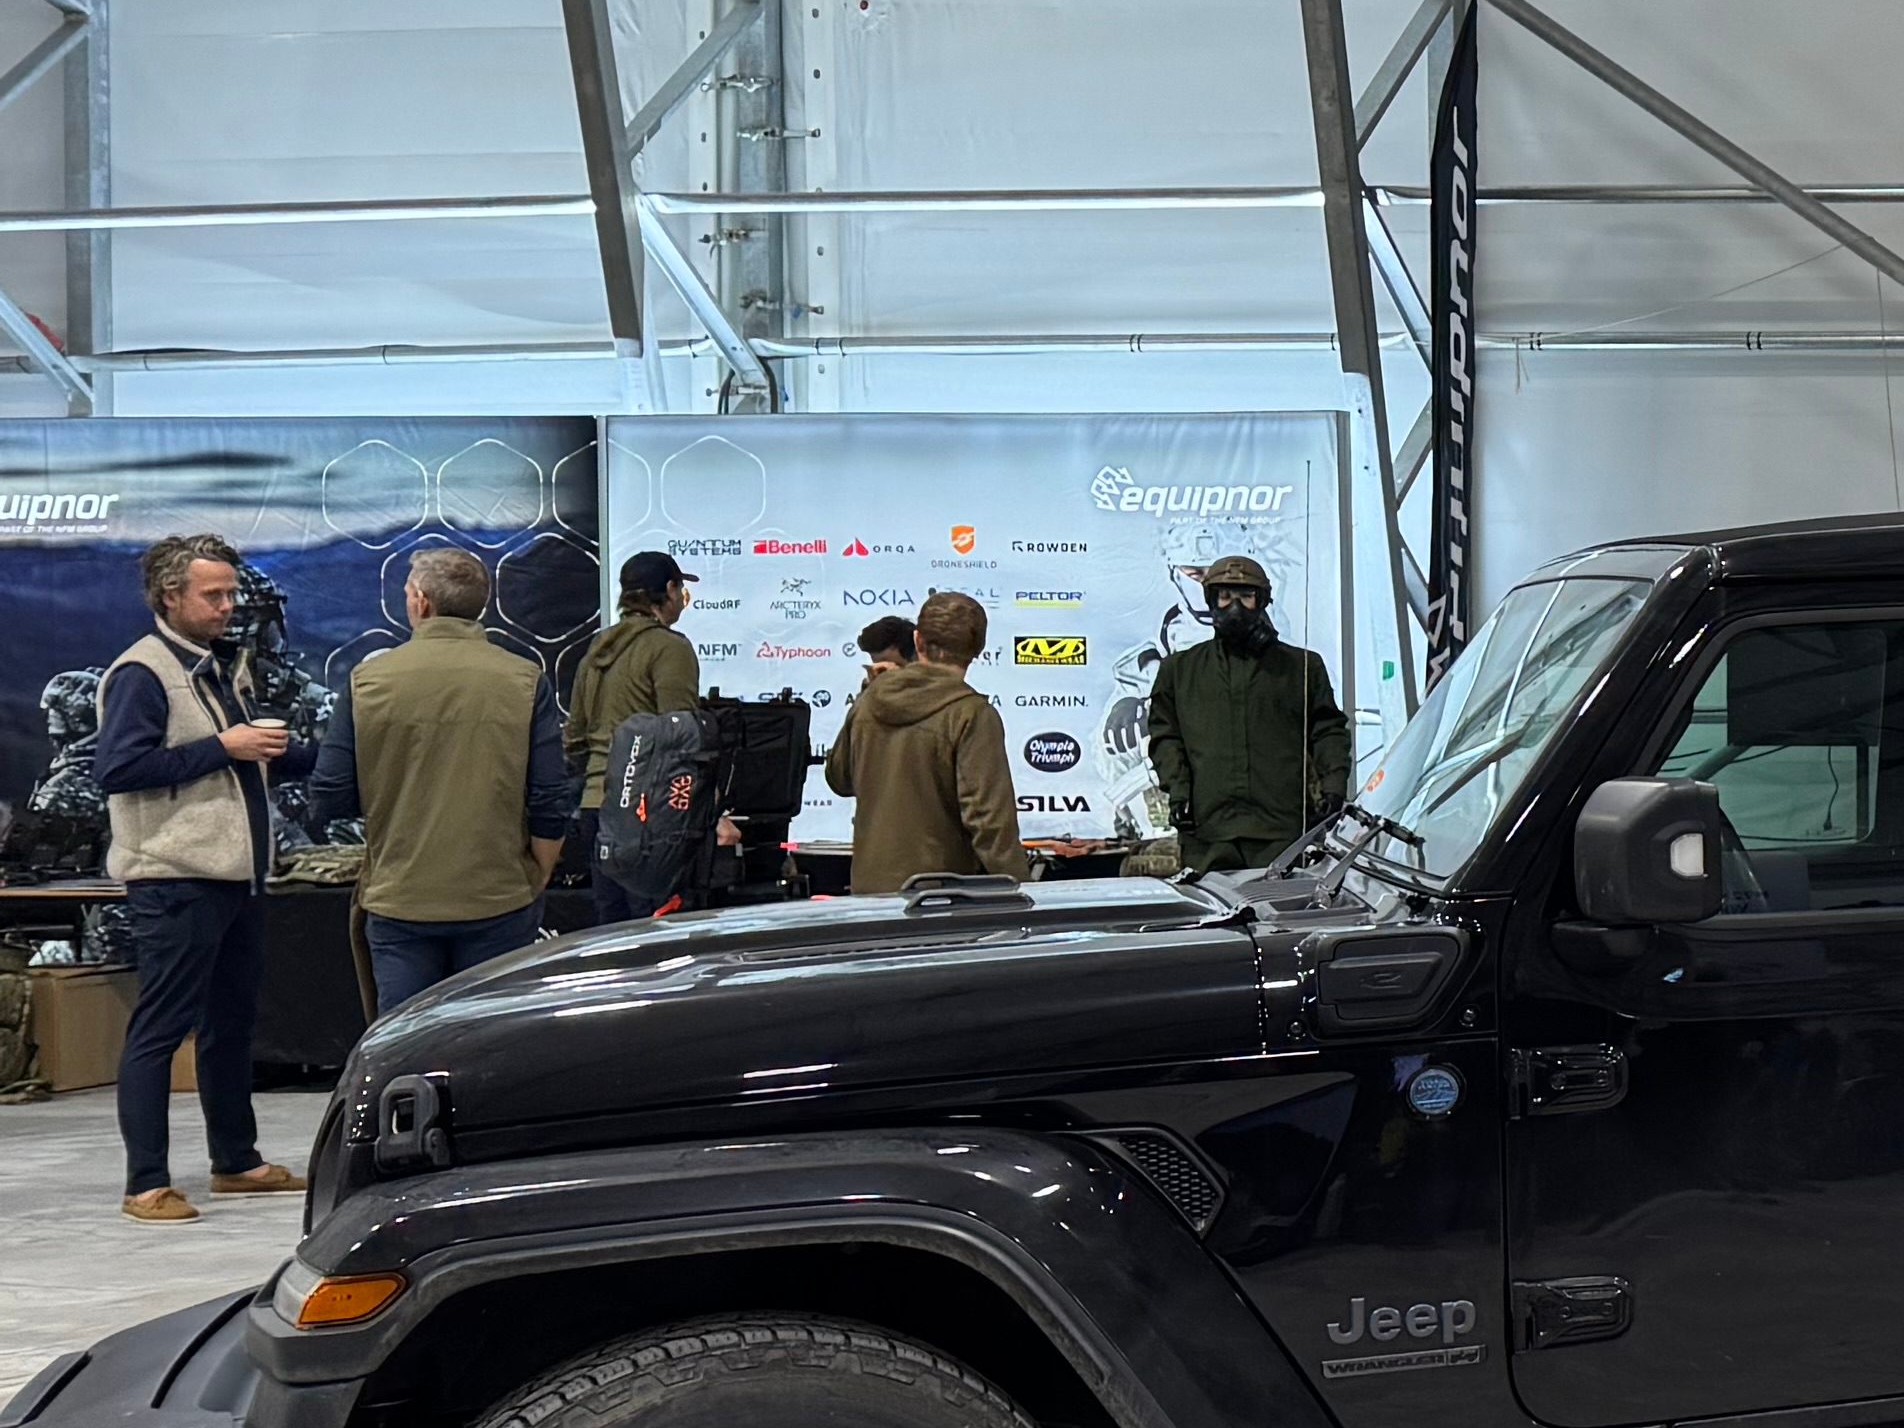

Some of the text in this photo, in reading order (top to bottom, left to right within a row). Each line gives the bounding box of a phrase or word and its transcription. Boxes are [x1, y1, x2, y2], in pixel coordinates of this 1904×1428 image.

[1119, 484, 1293, 518] equipnor
[0, 493, 120, 526] uipnor
[768, 539, 828, 555] Benelli
[872, 545, 916, 554] ORQA
[1026, 542, 1088, 553] ROWDEN
[930, 559, 998, 569] DRONESHIELD
[692, 598, 742, 610] CloudRF
[843, 588, 915, 606] NOKIA
[1015, 591, 1084, 601] PELTOR
[698, 643, 738, 657] NFM
[774, 645, 832, 661] Typhoon
[1030, 751, 1076, 765] Triumph
[619, 734, 643, 809] ORTOVOX
[1016, 795, 1092, 813] SILVA
[1326, 1297, 1477, 1345] Jeep
